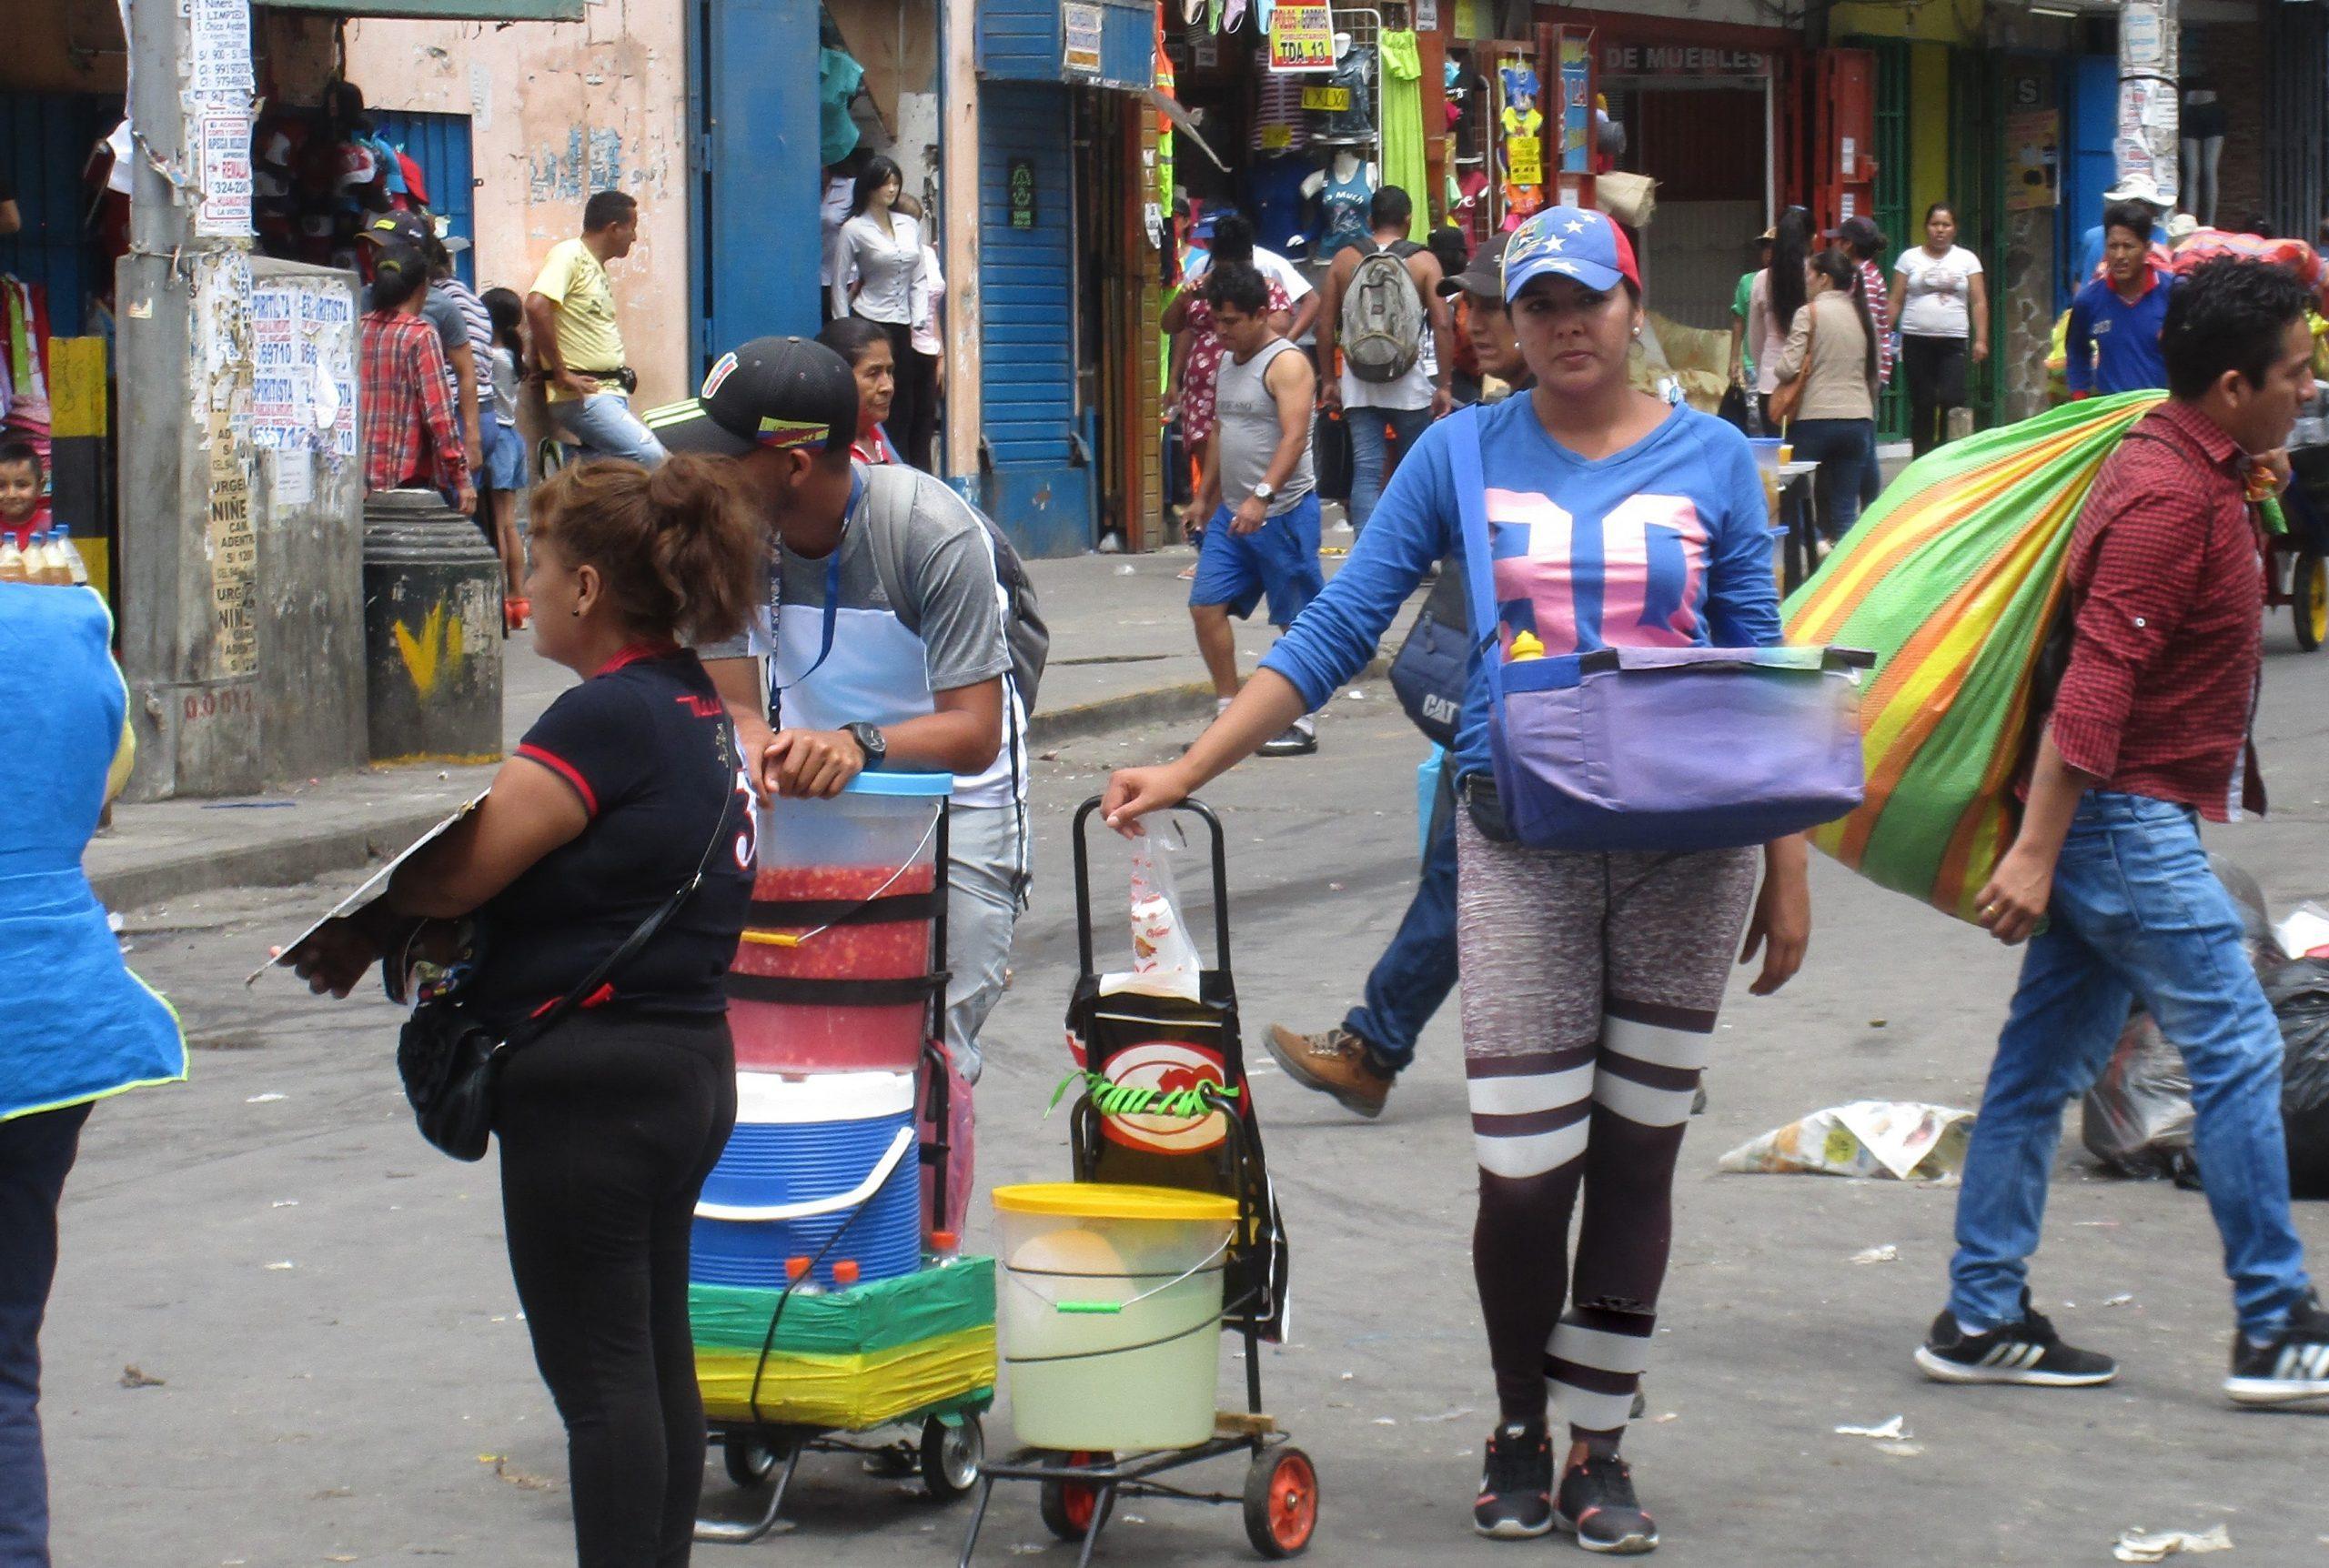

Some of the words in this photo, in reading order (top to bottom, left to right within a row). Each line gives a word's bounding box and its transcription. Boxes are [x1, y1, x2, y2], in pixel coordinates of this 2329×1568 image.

[1311, 40, 1326, 64] 13
[1607, 47, 1638, 69] DE
[1646, 47, 1764, 69] MUEBLES
[1336, 190, 1365, 206] Much
[1422, 693, 1458, 725] CAT
